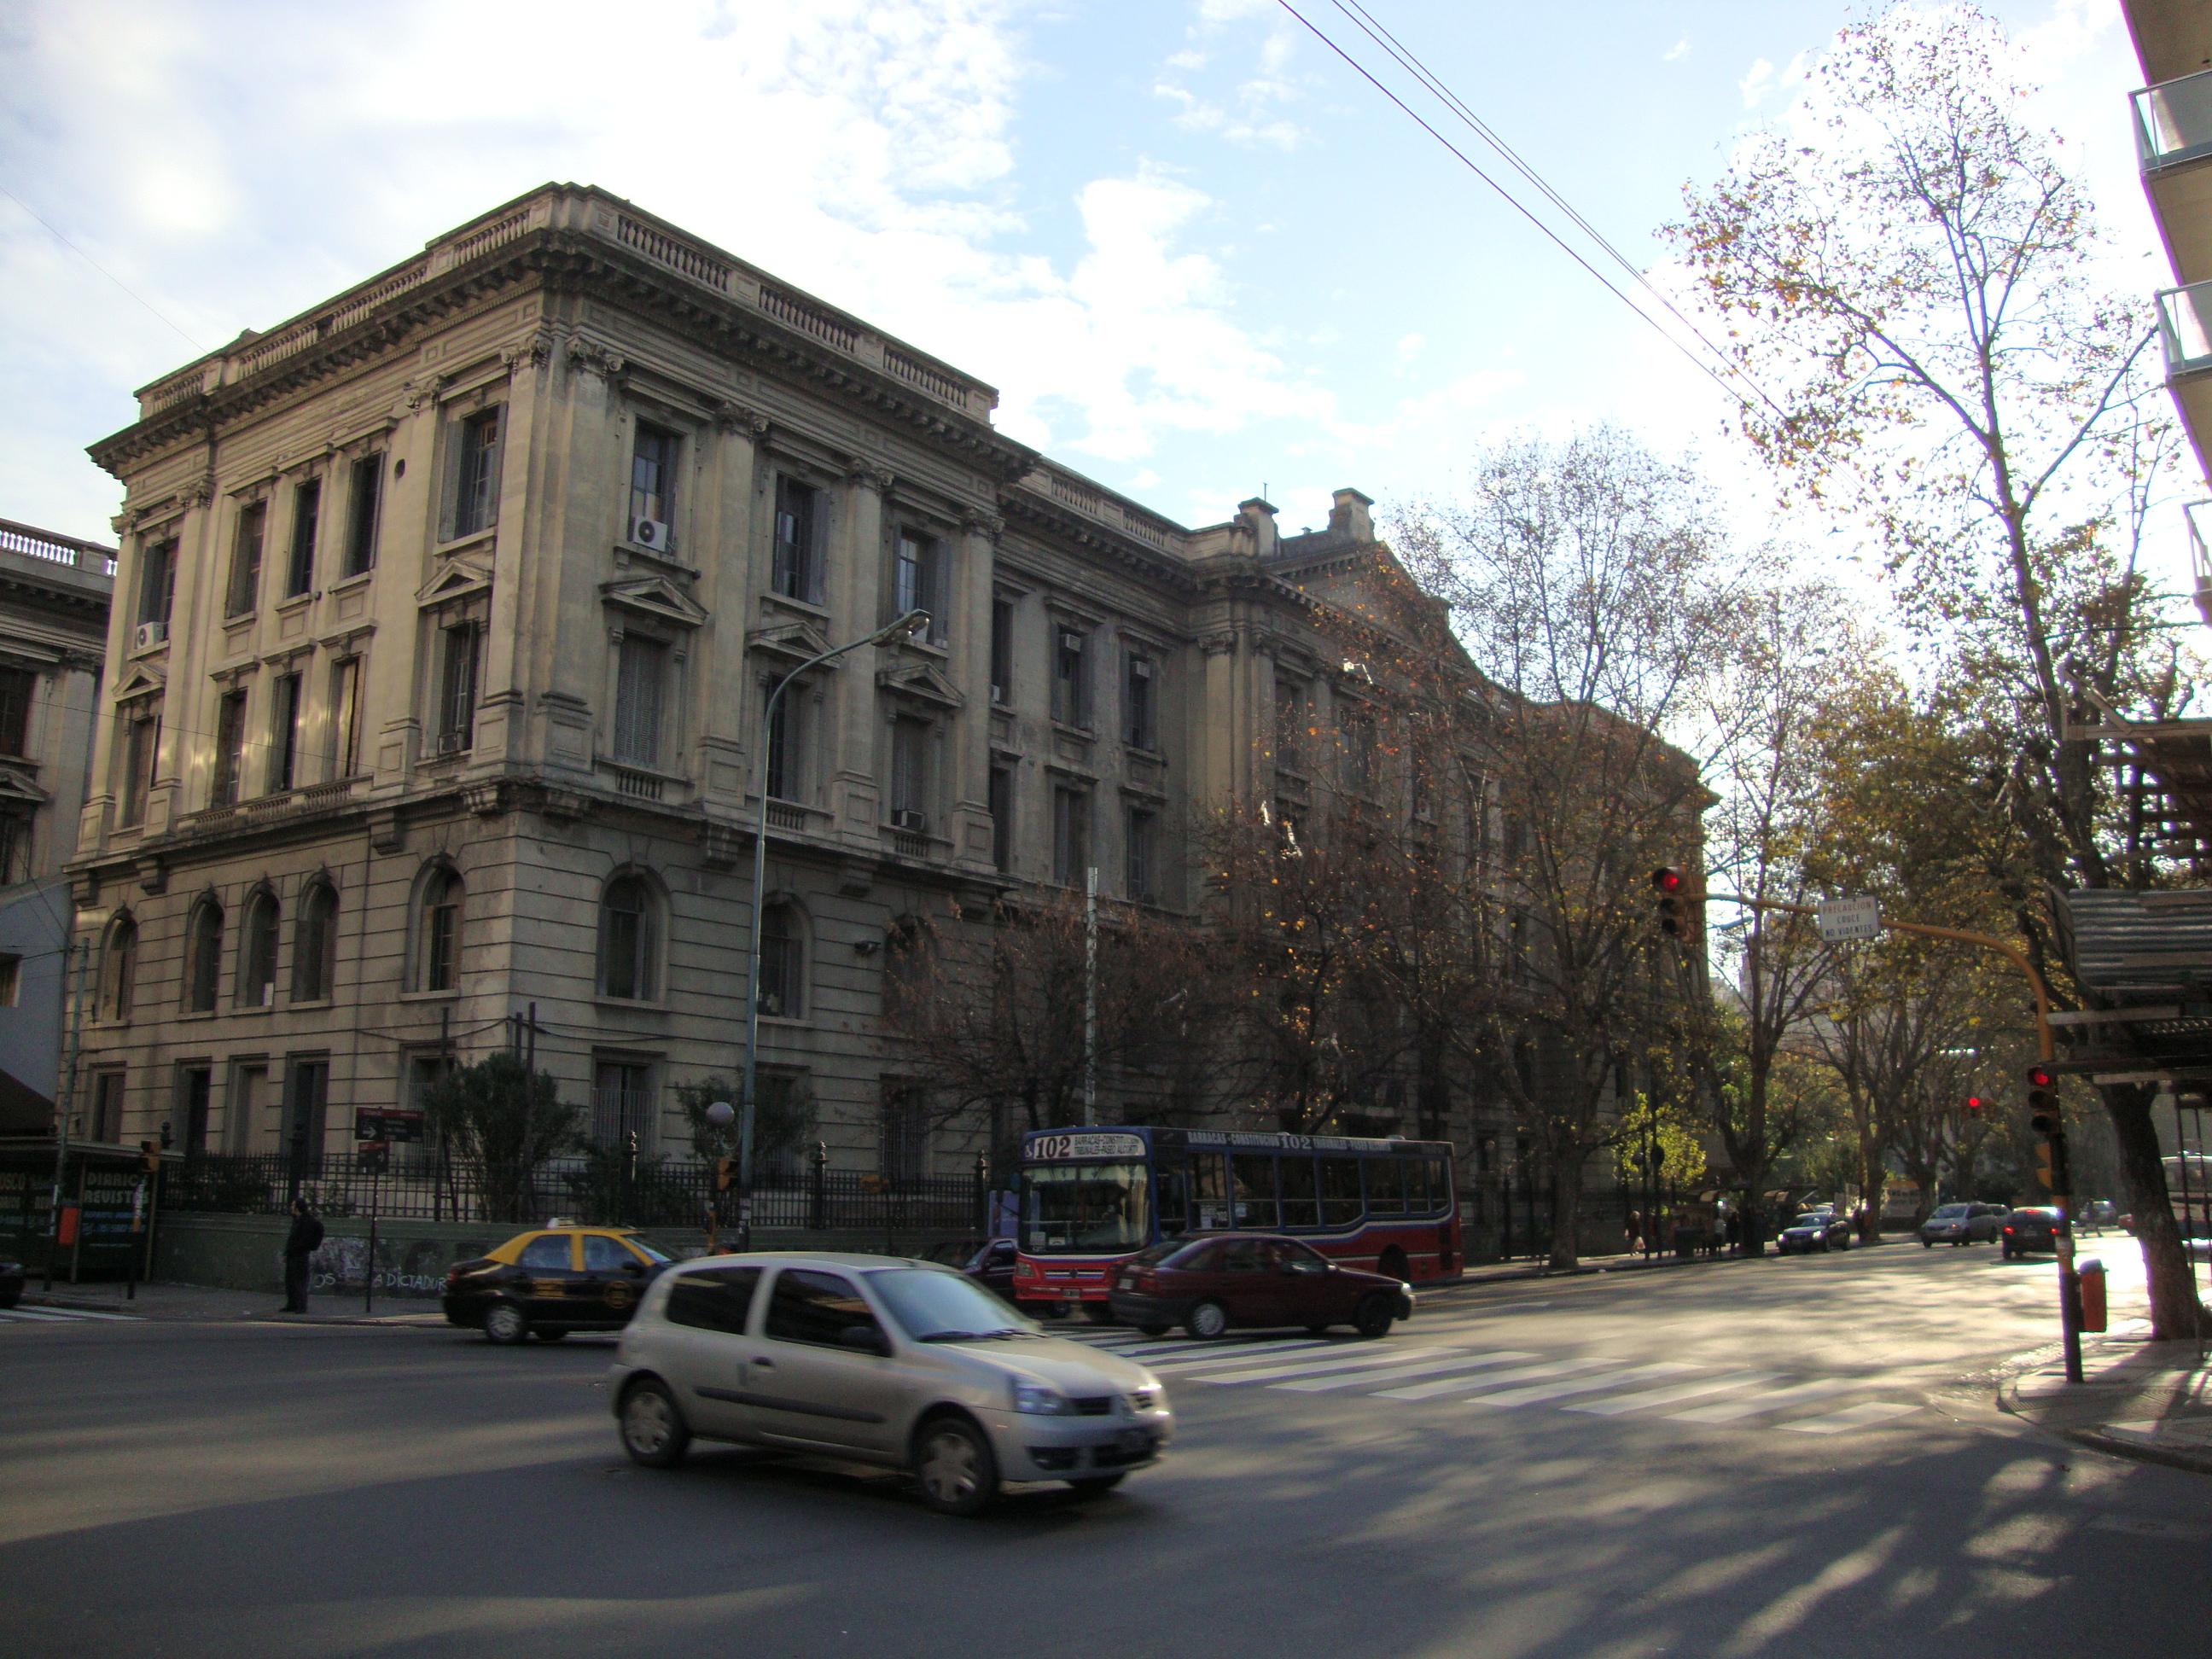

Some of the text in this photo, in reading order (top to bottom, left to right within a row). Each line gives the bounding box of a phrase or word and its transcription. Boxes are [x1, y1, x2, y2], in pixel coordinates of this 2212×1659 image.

[1036, 1136, 1071, 1158] 102
[1281, 1135, 1312, 1150] 102
[87, 1171, 145, 1187] DIARIO
[84, 1190, 150, 1204] REVISTS
[387, 1275, 446, 1290] DICTADUR
